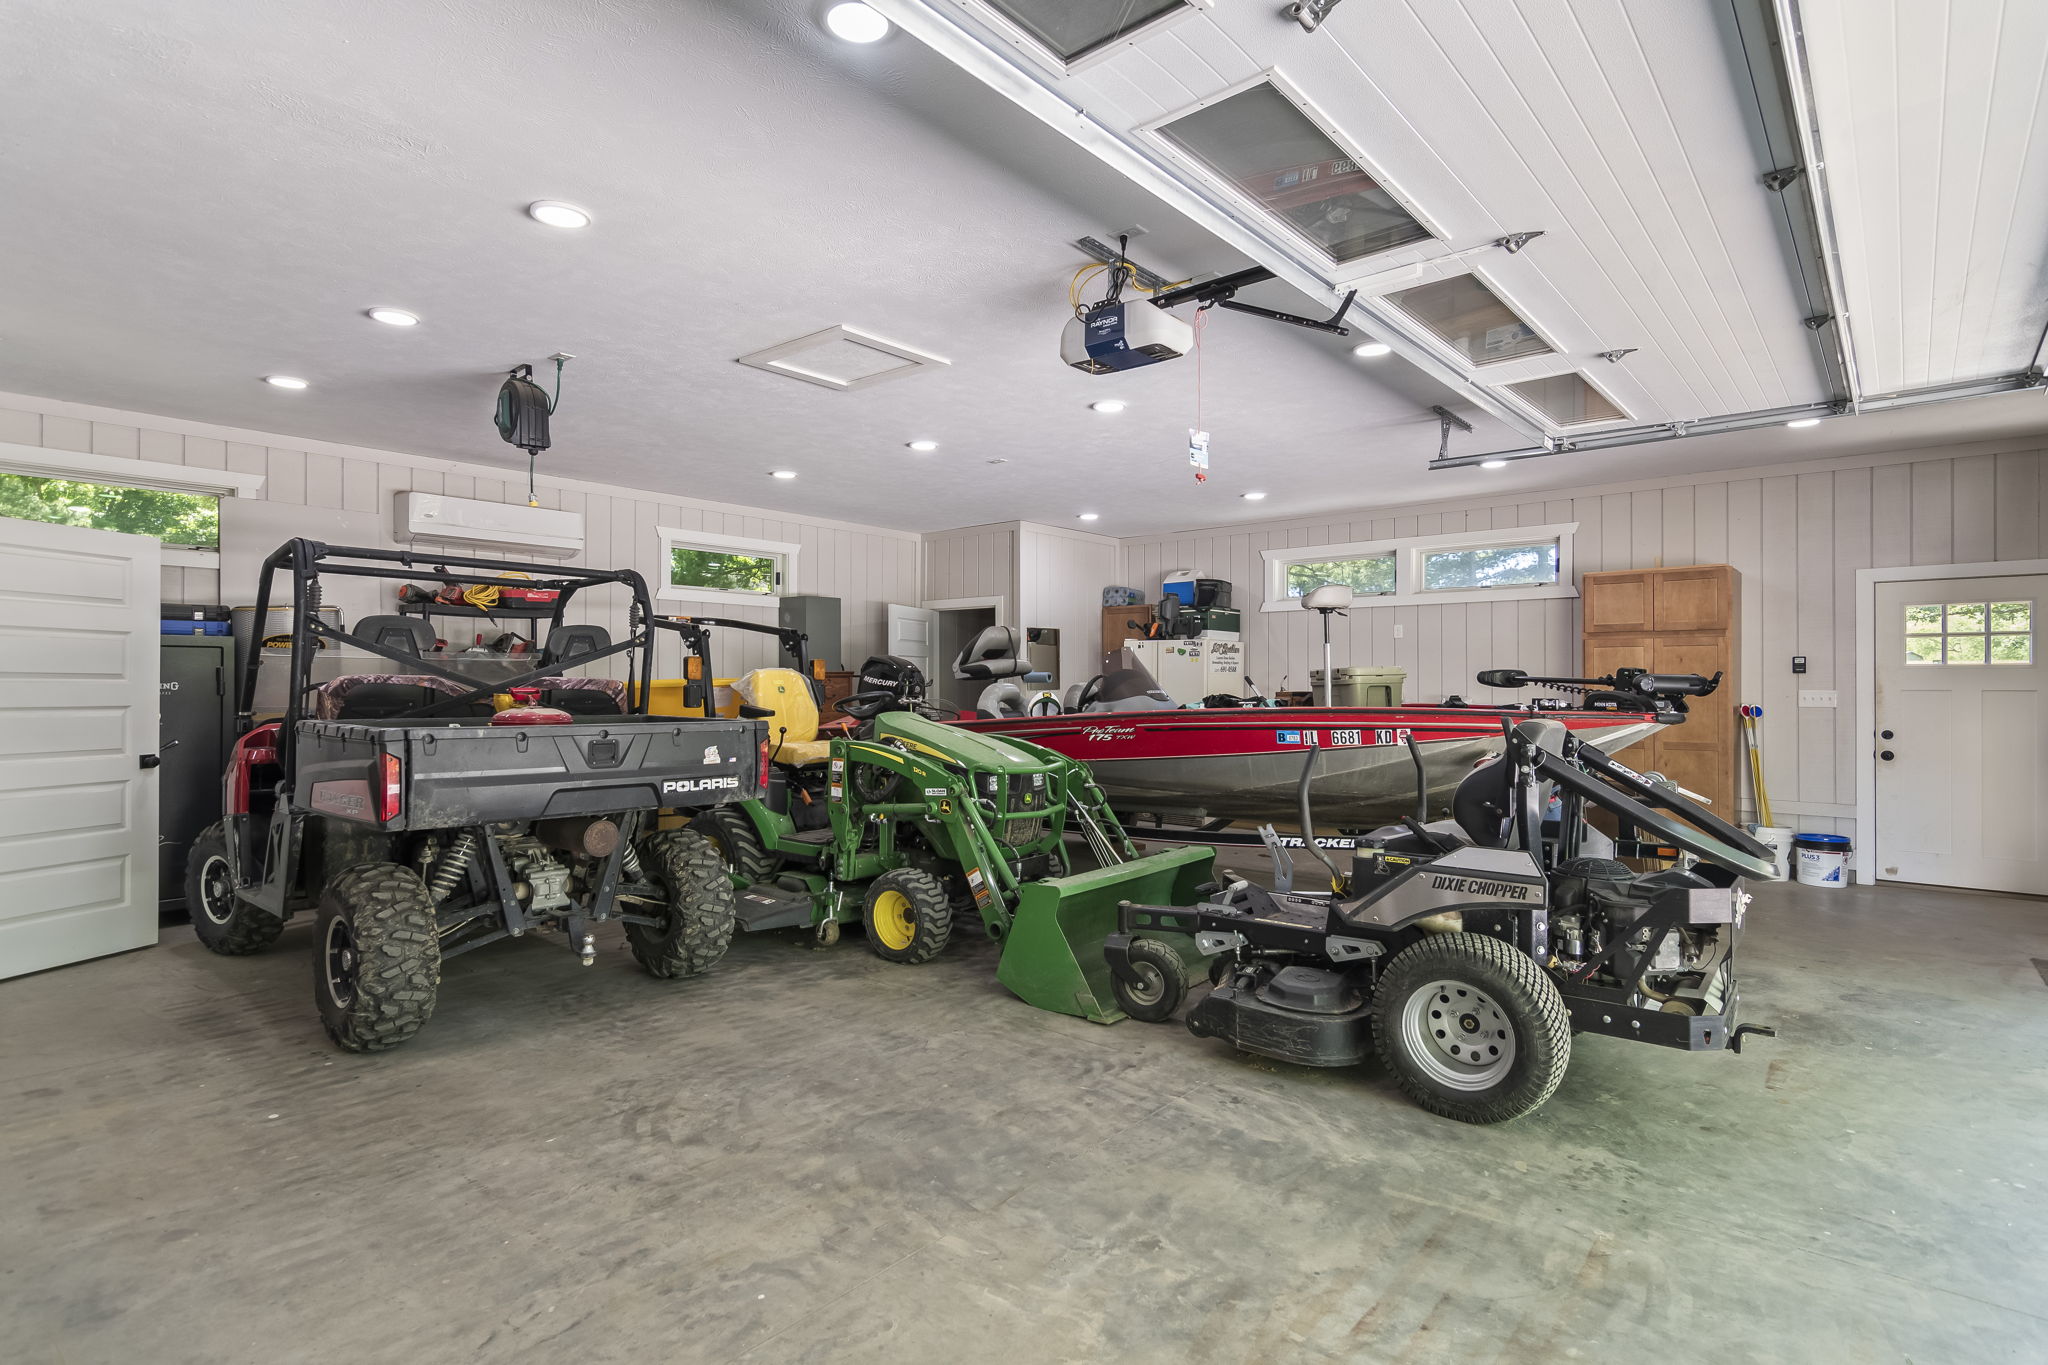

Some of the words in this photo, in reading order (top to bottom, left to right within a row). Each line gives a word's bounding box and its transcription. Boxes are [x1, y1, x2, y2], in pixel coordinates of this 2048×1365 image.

[1090, 317, 1118, 329] RAYNOR
[863, 675, 899, 688] MERCURY
[1089, 733, 1114, 742] 175
[1278, 732, 1286, 743] B
[1304, 731, 1318, 745] IL
[1331, 730, 1361, 745] 6681
[1375, 730, 1392, 745] KD
[663, 776, 739, 794] POLARIS
[1802, 852, 1815, 860] PLUS
[1431, 875, 1467, 893] DIXIE
[1467, 880, 1528, 901] CHOPPER
